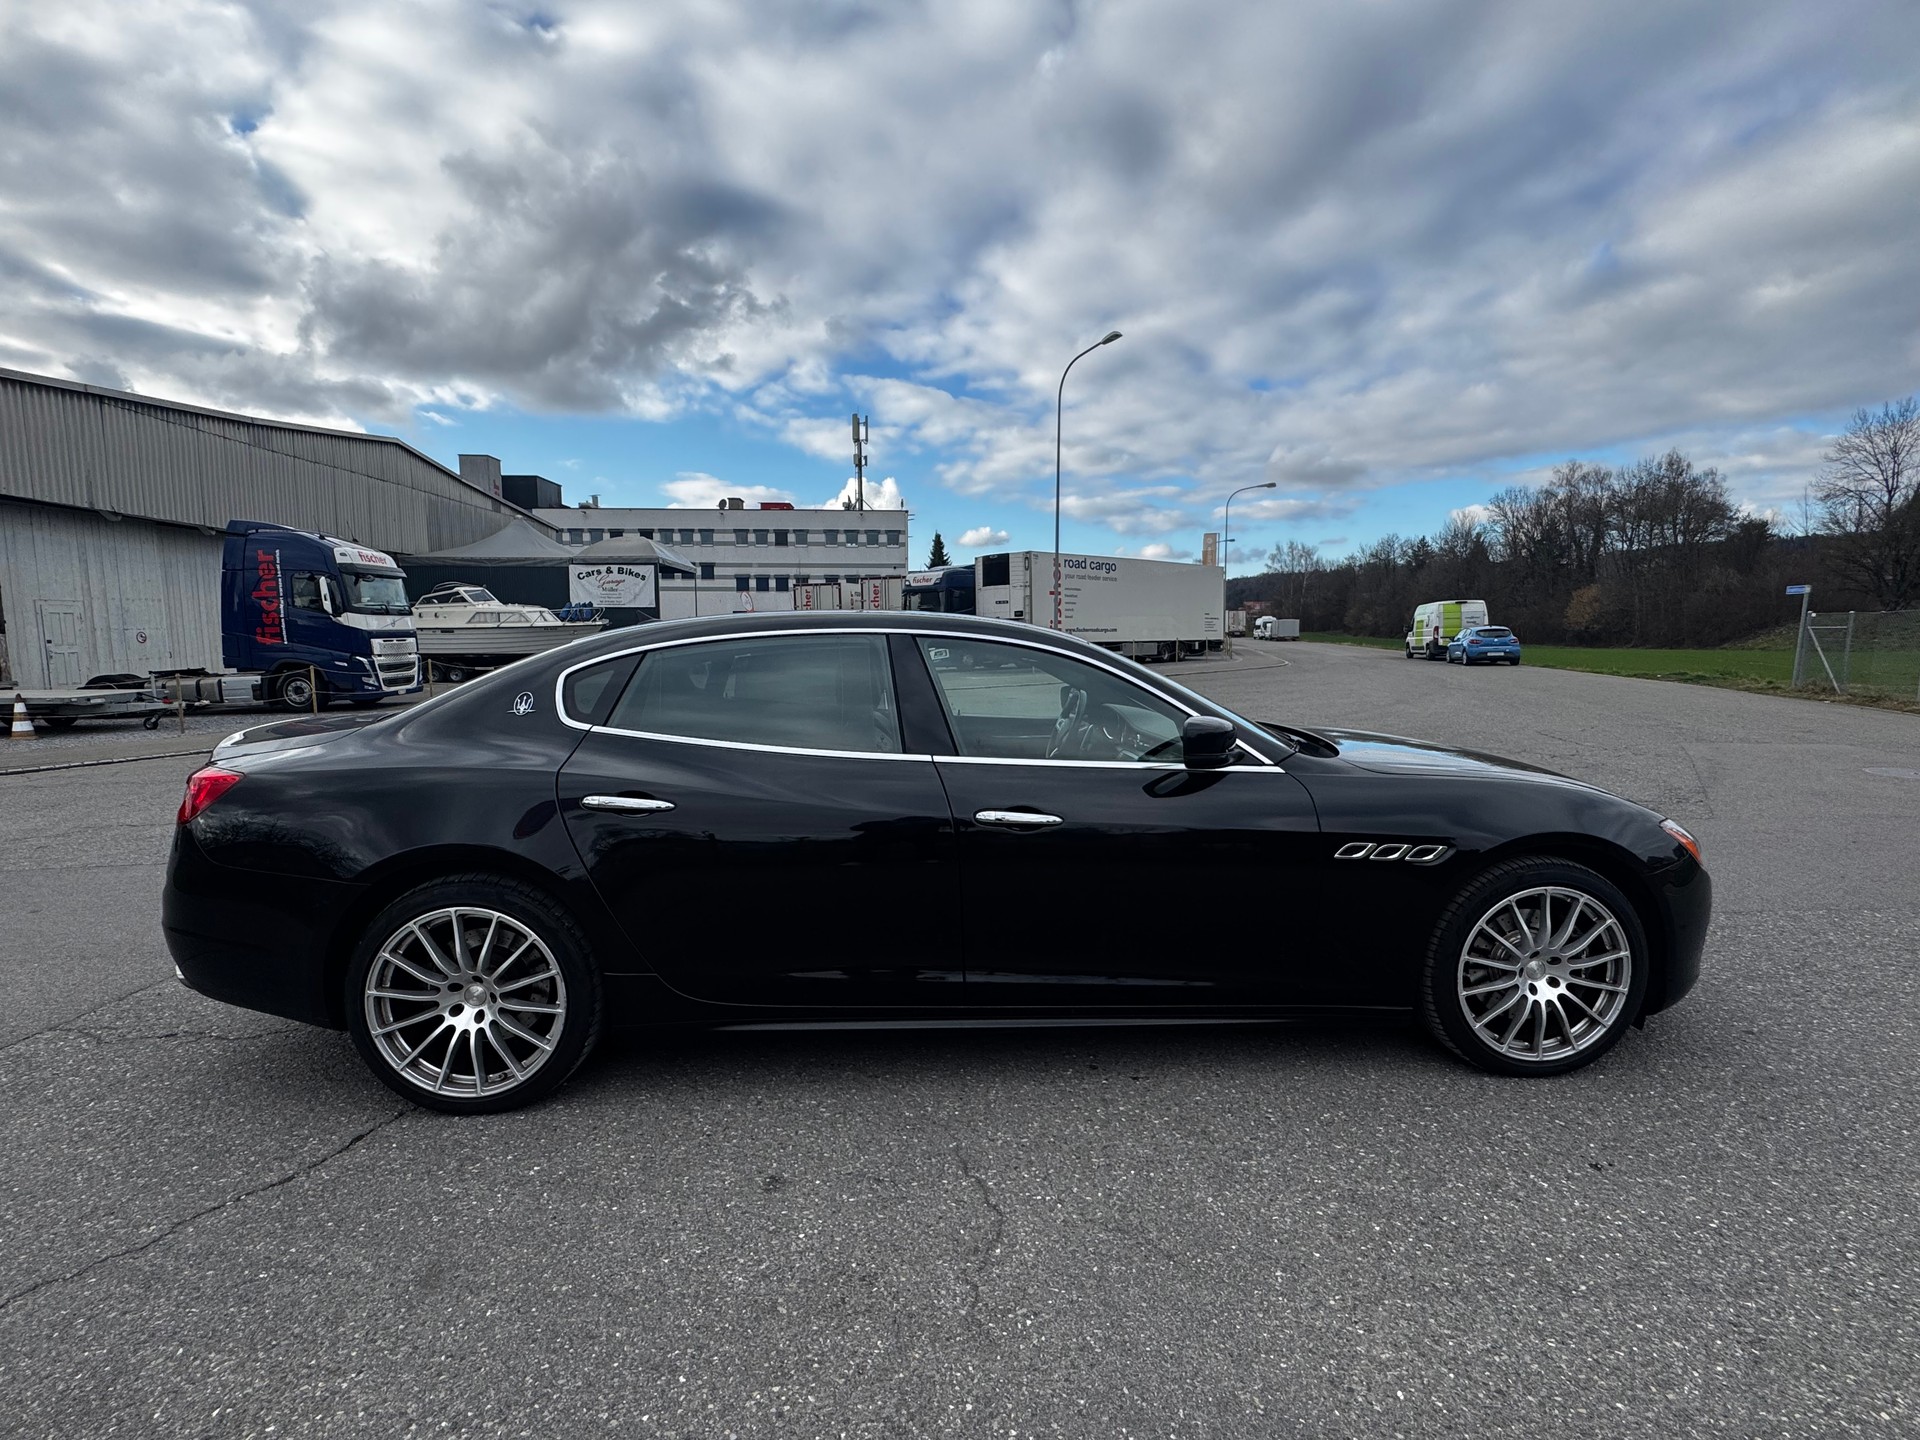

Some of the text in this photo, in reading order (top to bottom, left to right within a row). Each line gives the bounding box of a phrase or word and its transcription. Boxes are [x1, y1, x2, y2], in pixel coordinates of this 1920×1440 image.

[357, 551, 387, 565] fischer
[577, 566, 647, 581] Cars & Bikes
[1063, 558, 1117, 574] road cargo
[912, 576, 933, 584] fischer
[251, 549, 282, 645] fischer
